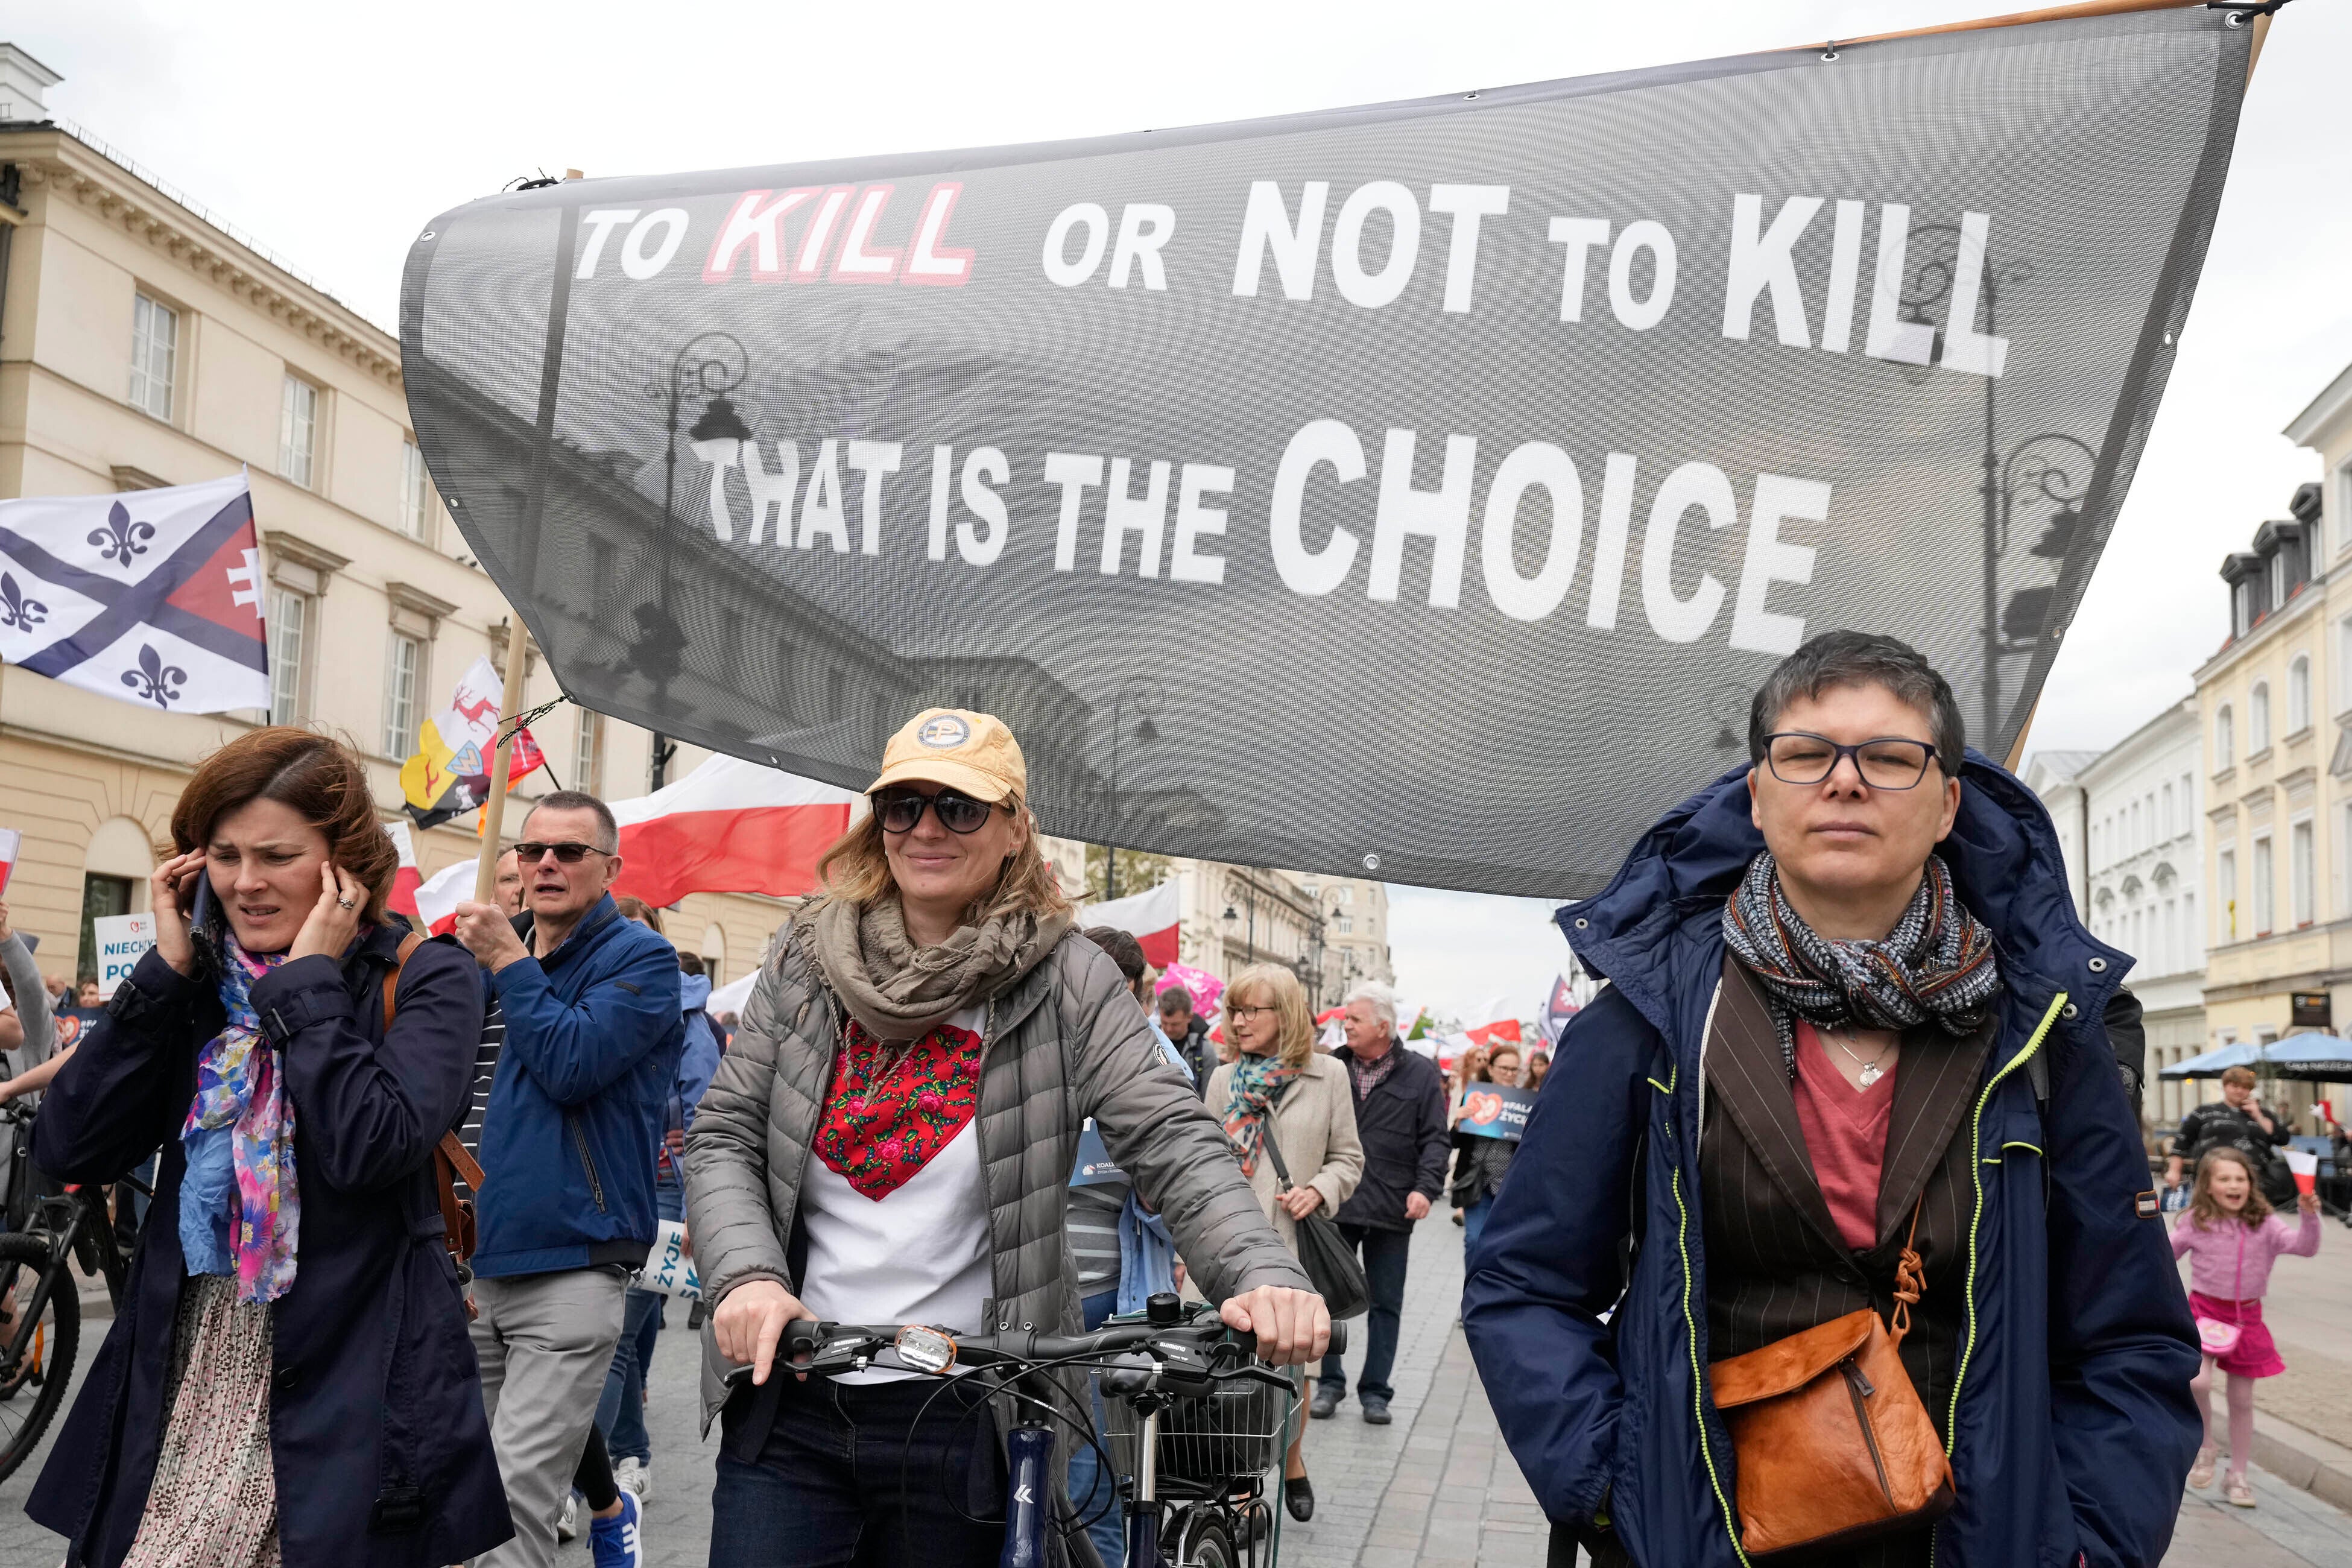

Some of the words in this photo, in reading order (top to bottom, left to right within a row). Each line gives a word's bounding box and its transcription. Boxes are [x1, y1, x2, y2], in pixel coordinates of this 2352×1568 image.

[574, 207, 690, 280] TO
[701, 180, 976, 286] KILL
[1041, 201, 1177, 291] OR
[1231, 180, 1511, 314] NOT
[1547, 216, 1678, 330] TO
[1722, 193, 2009, 378] KILL
[690, 438, 903, 556] THAT
[927, 444, 1011, 566] IS
[1044, 451, 1236, 584] THE
[1269, 419, 1833, 656] CHOICE
[833, 1338, 862, 1347] SHIMANO
[1159, 1341, 1186, 1352] SHIMANO
